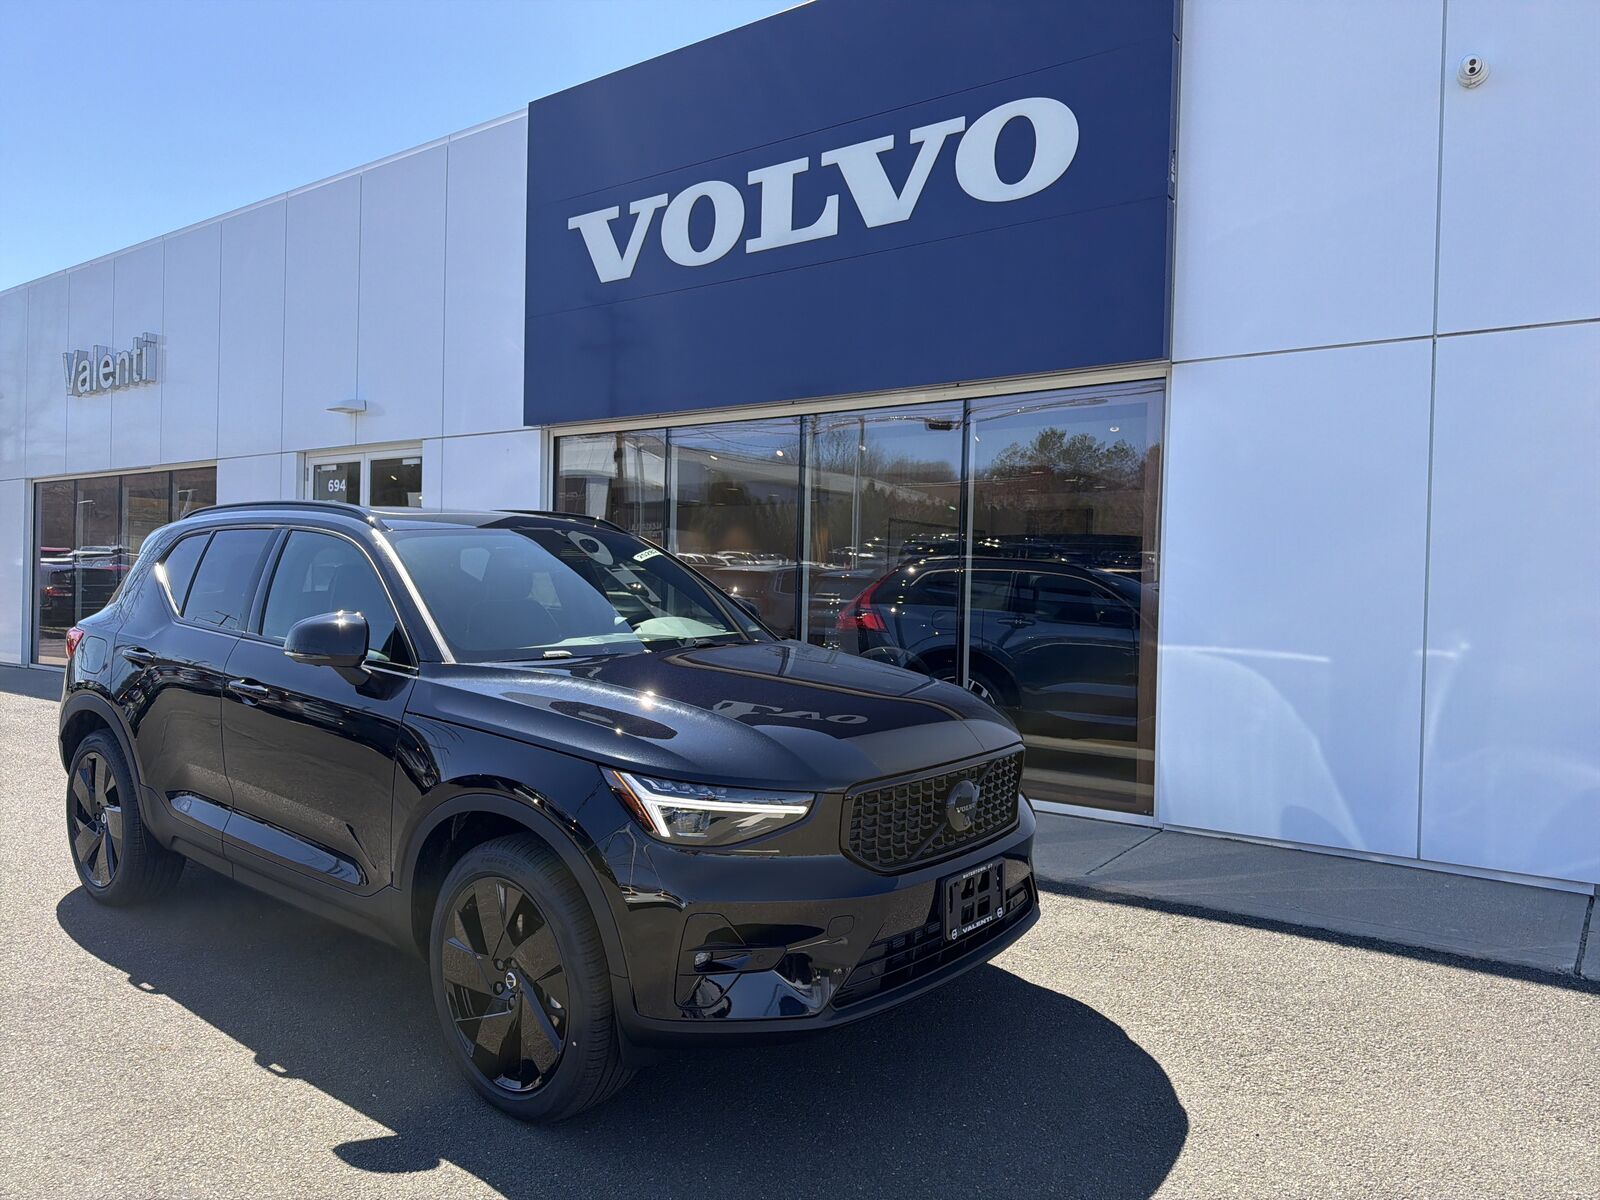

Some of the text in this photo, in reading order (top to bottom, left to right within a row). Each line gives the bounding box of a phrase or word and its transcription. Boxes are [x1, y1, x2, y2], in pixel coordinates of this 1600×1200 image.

[568, 97, 1079, 283] VOLVO
[62, 332, 157, 397] Valenti
[328, 479, 346, 492] 694
[962, 916, 993, 934] VALENTI
